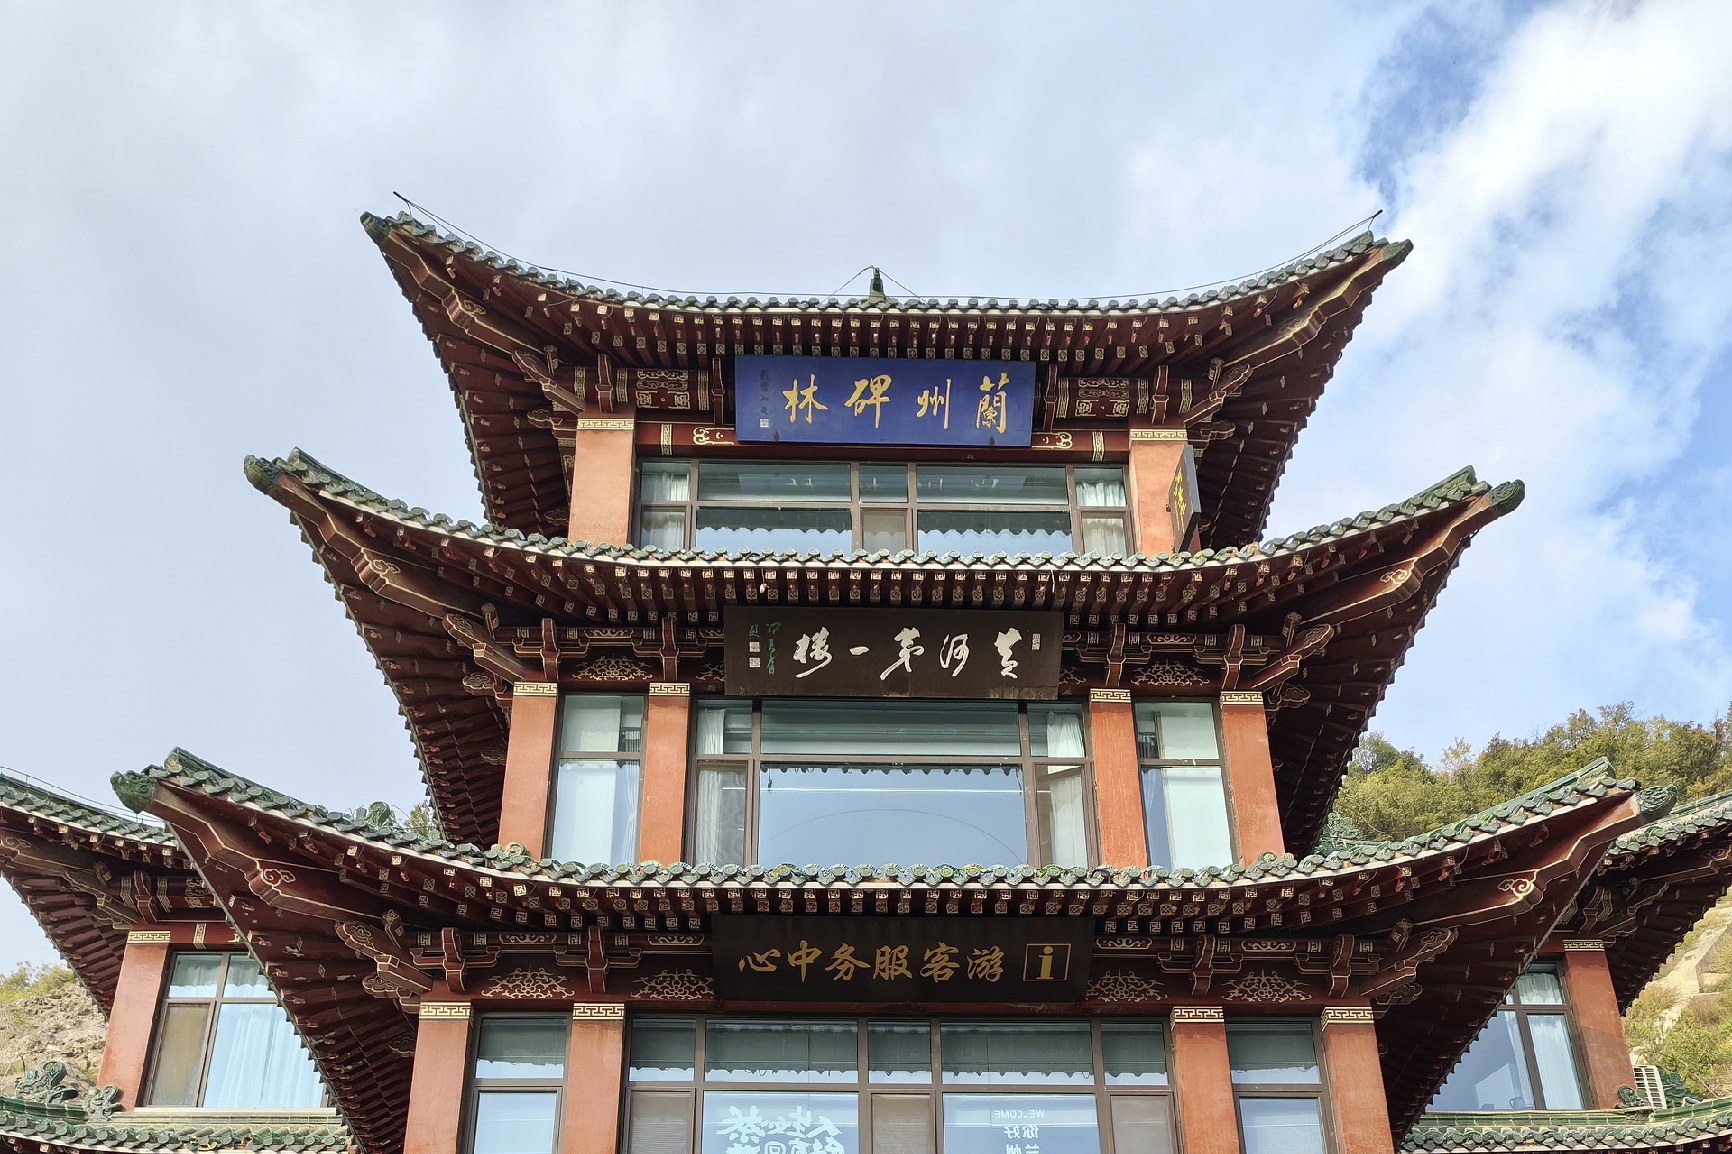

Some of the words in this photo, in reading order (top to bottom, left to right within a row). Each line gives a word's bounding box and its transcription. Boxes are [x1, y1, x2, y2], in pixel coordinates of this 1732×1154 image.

[738, 939, 1005, 983] 游客服务中心
